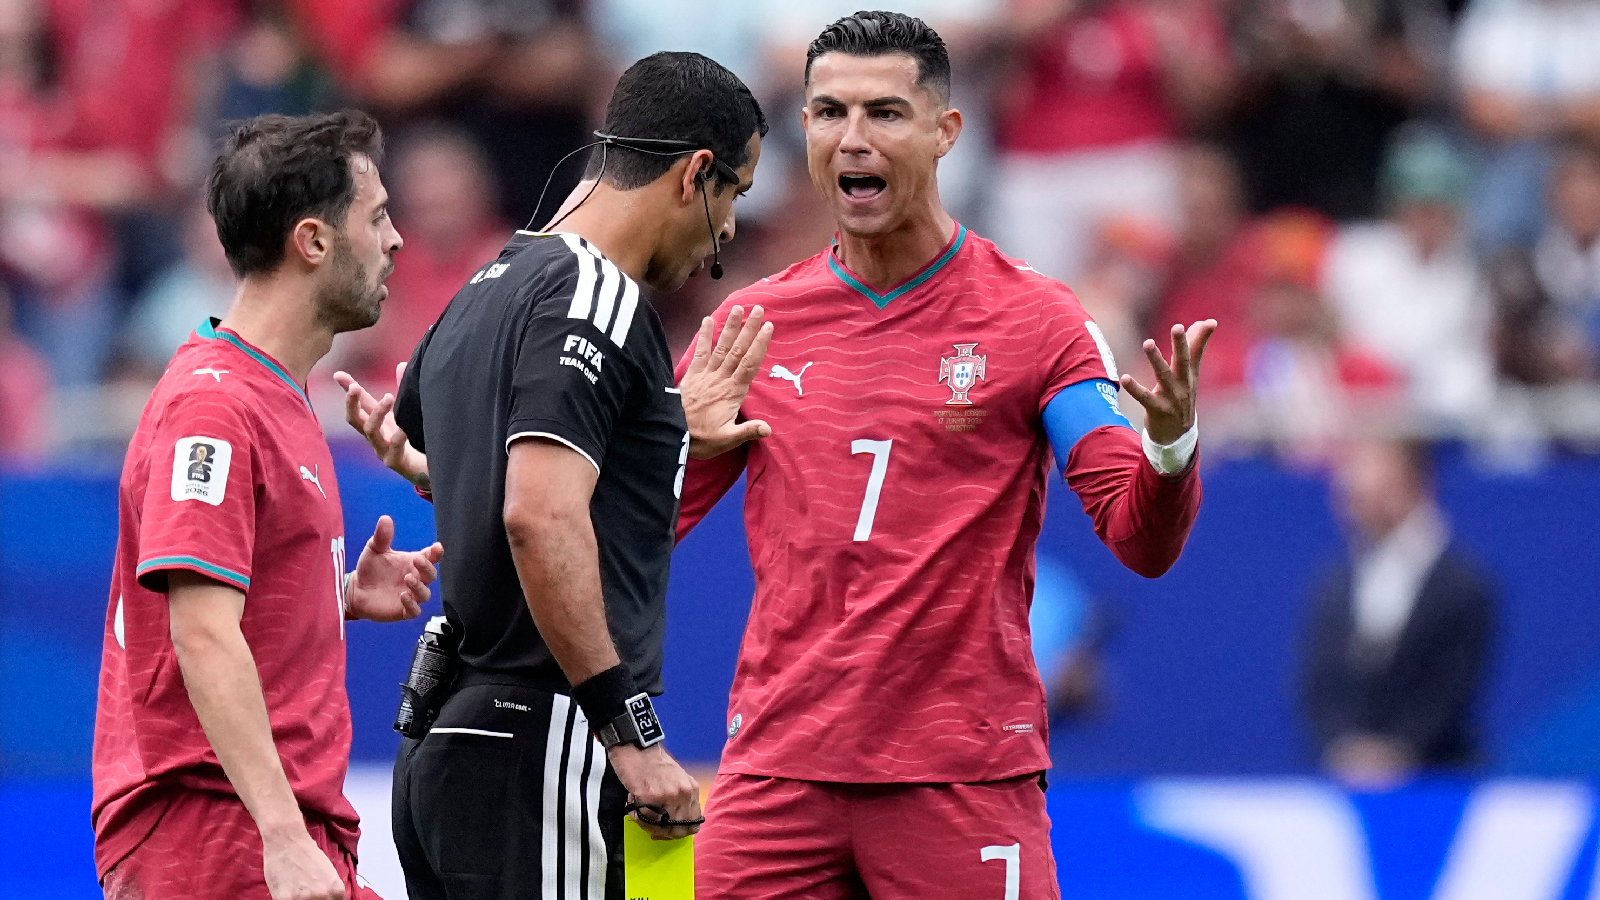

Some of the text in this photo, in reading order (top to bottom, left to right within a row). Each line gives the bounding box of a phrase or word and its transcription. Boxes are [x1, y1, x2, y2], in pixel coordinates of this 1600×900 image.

[559, 356, 599, 385] TEAM ONE
[563, 334, 603, 373] FIFA
[185, 488, 208, 496] 2026
[851, 438, 893, 541] 7
[980, 842, 1020, 900] 7
